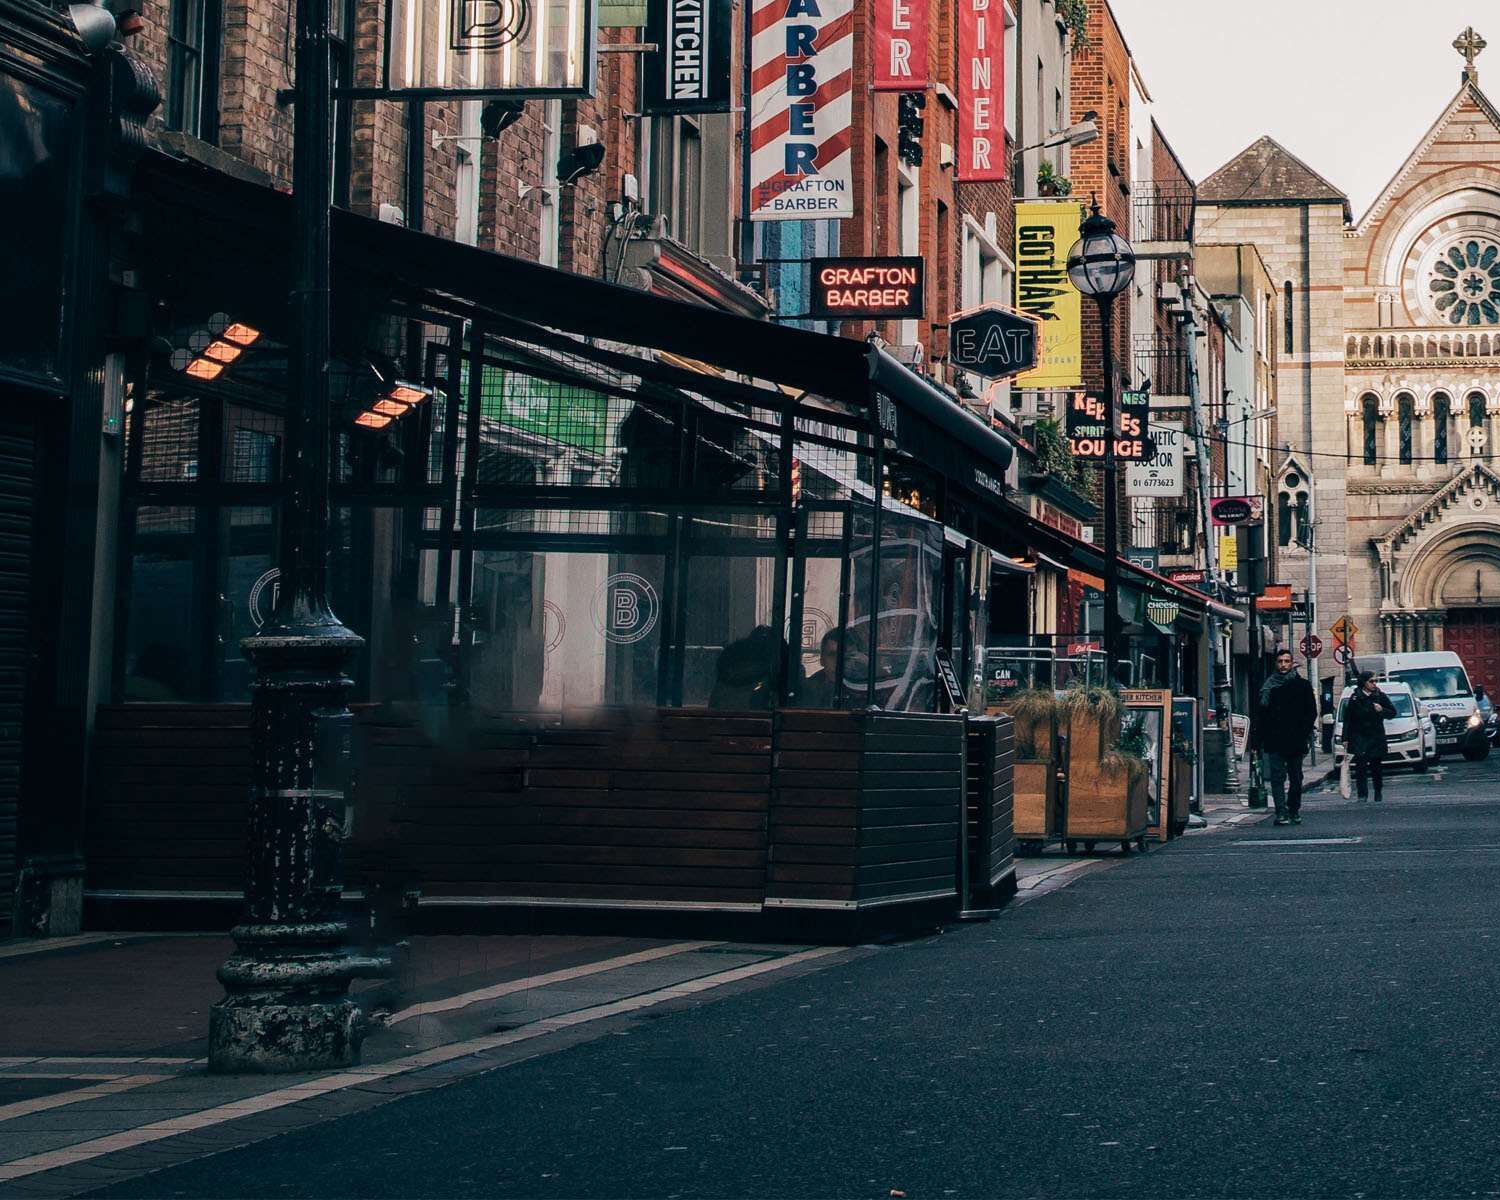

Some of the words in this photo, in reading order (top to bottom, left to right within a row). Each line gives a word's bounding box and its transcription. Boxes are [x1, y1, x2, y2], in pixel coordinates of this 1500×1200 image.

[771, 179, 845, 192] GRAFTON
[774, 197, 838, 211] BARBER
[820, 269, 916, 287] GRAFTON
[1019, 226, 1073, 320] GOTHAM
[826, 289, 909, 307] BARBER
[955, 324, 1031, 364] EAT
[1075, 425, 1105, 437] SPIRIT
[1147, 600, 1180, 609] CHEESE
[1300, 642, 1322, 652] SOP
[995, 670, 1011, 679] CAN
